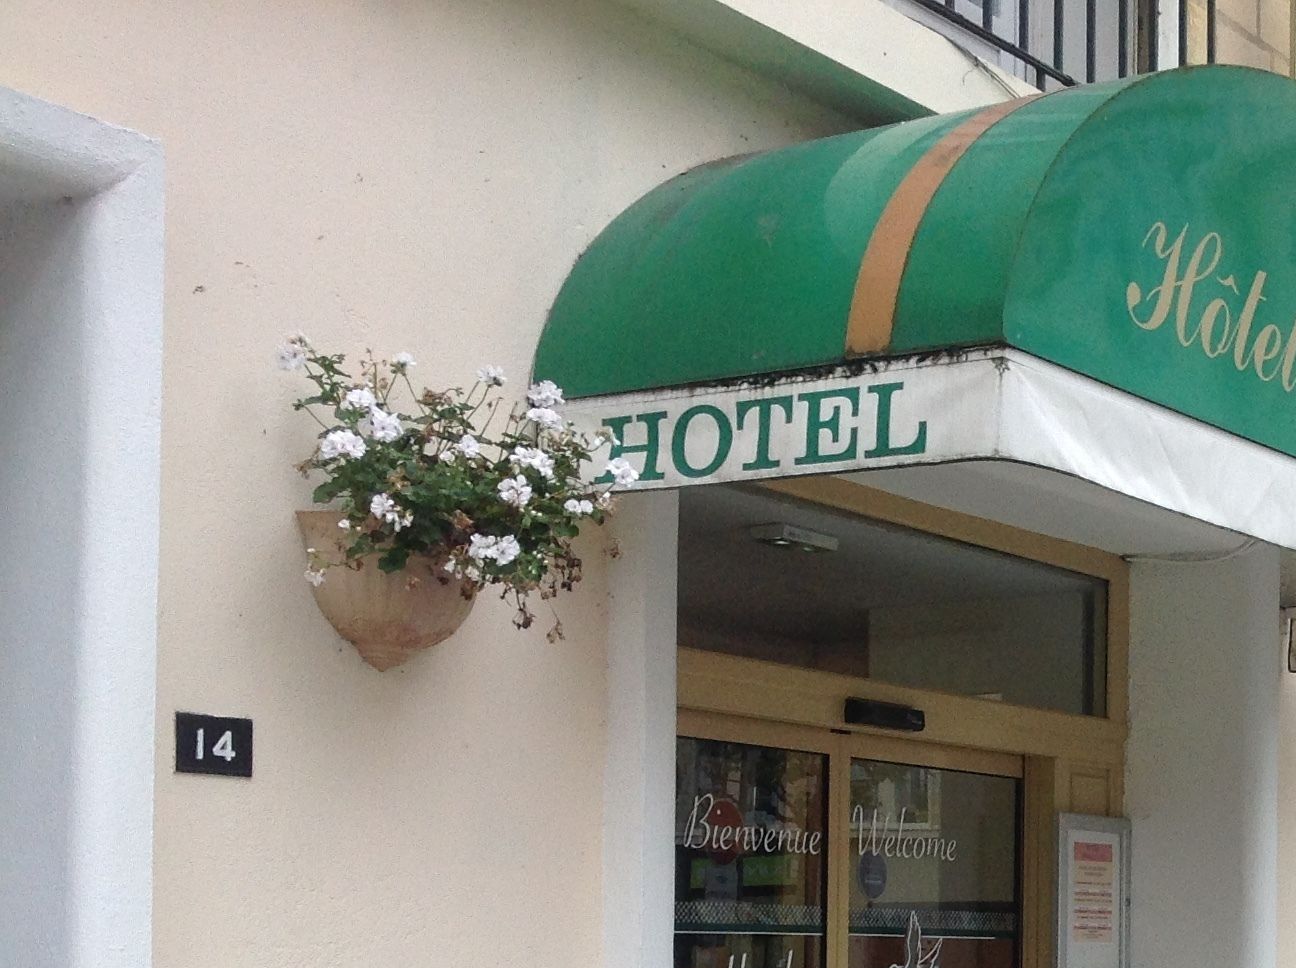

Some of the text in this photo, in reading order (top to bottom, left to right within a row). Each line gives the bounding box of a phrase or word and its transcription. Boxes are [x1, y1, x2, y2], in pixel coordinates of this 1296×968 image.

[593, 381, 928, 485] HOTEL
[195, 727, 236, 762] 14
[683, 792, 822, 855] Bienvenue
[852, 803, 958, 861] Welcome
